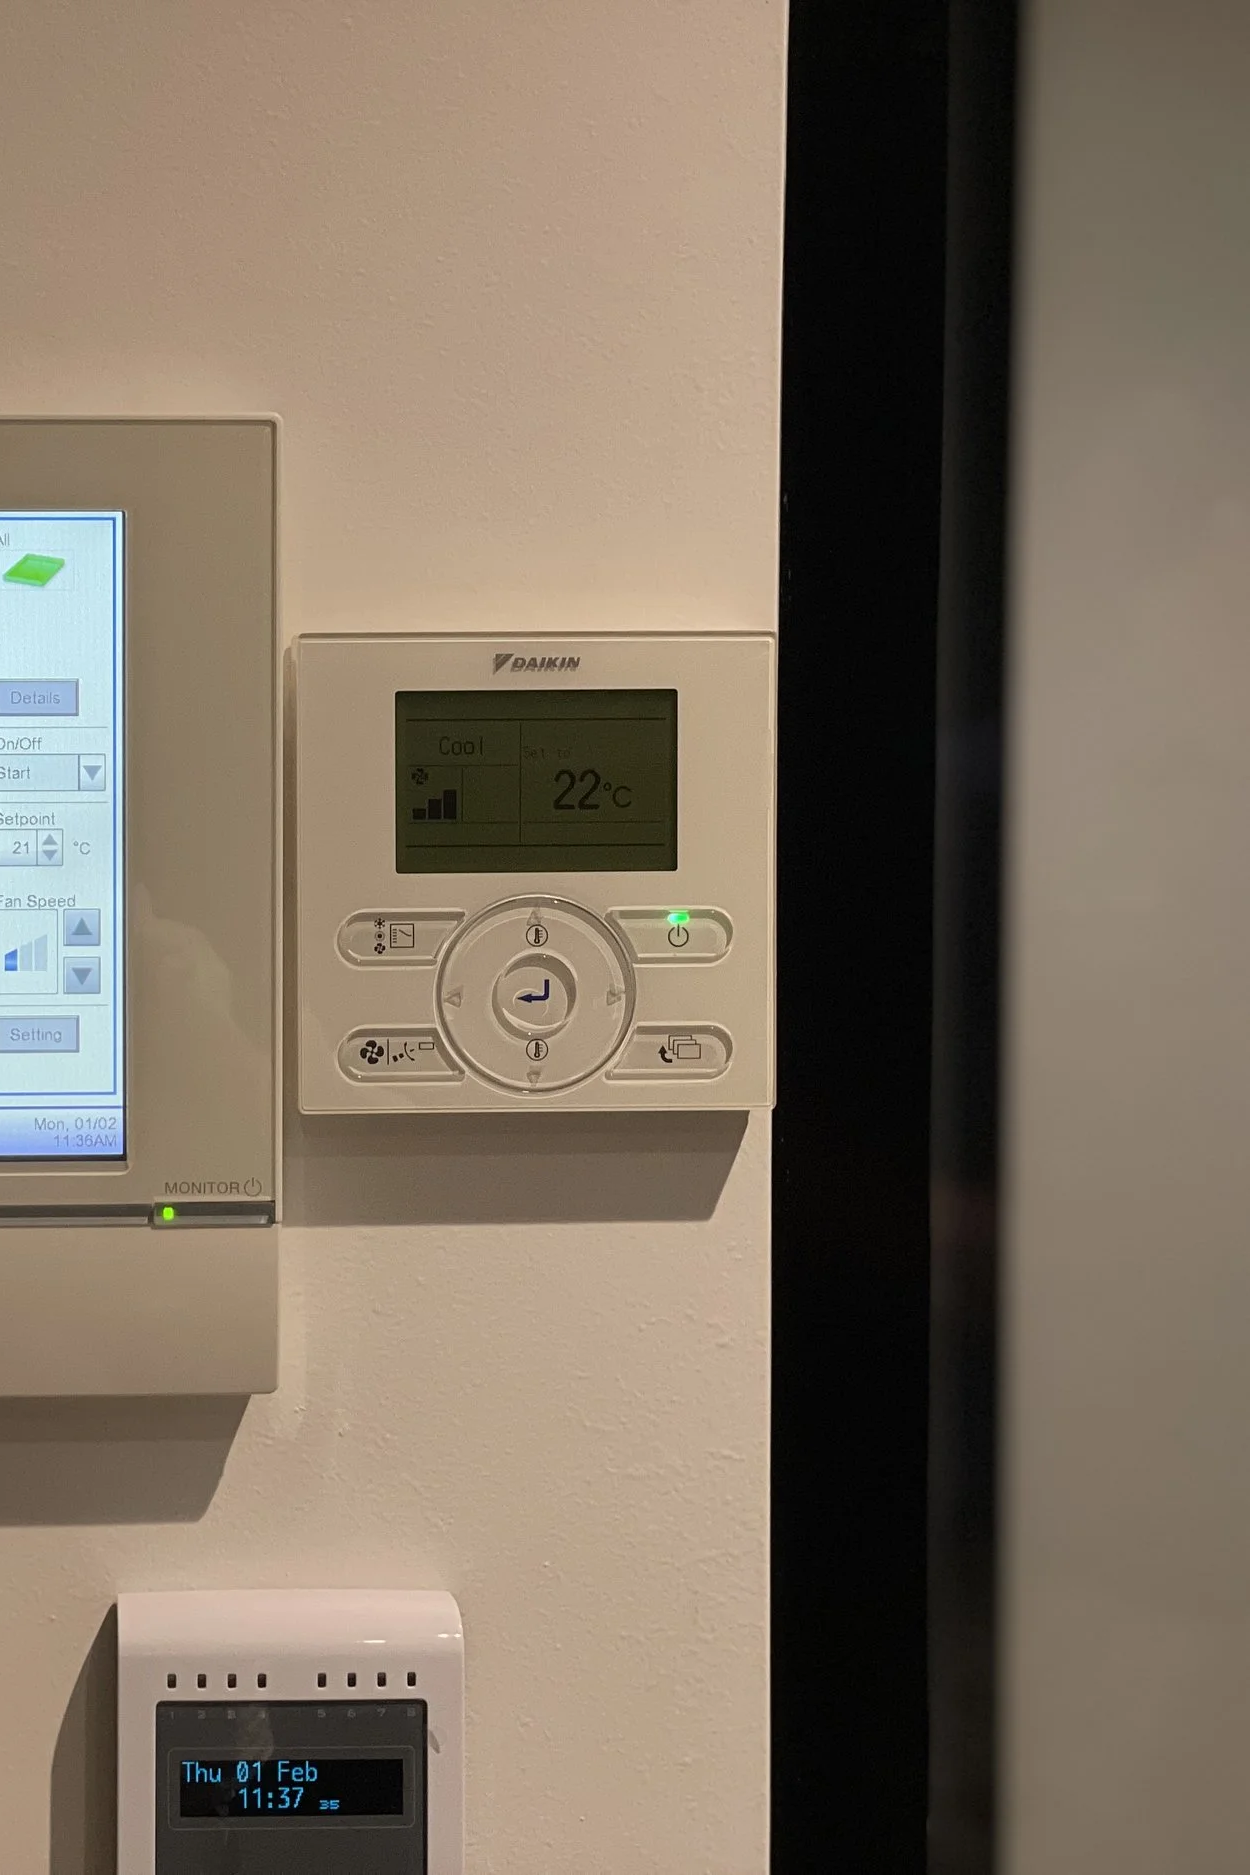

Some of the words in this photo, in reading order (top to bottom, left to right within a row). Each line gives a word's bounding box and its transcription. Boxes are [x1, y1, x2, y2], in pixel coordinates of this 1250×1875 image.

[510, 656, 581, 672] DAIKIN
[10, 691, 61, 704] Details
[438, 736, 485, 757] Cool
[12, 841, 30, 855] 21
[26, 894, 76, 910] Speed
[9, 1028, 62, 1042] Setting
[34, 1117, 69, 1132] Mon,
[74, 1117, 117, 1130] 01/02
[53, 1134, 117, 1148] 11:36AM
[164, 1180, 240, 1195] MONITOR
[317, 1708, 327, 1718] 5
[377, 1707, 387, 1718] 7
[181, 1761, 222, 1784] Thu
[236, 1761, 263, 1784] 01
[277, 1760, 318, 1783] Feb
[238, 1787, 305, 1810] 11:37
[318, 1799, 341, 1811] 35
